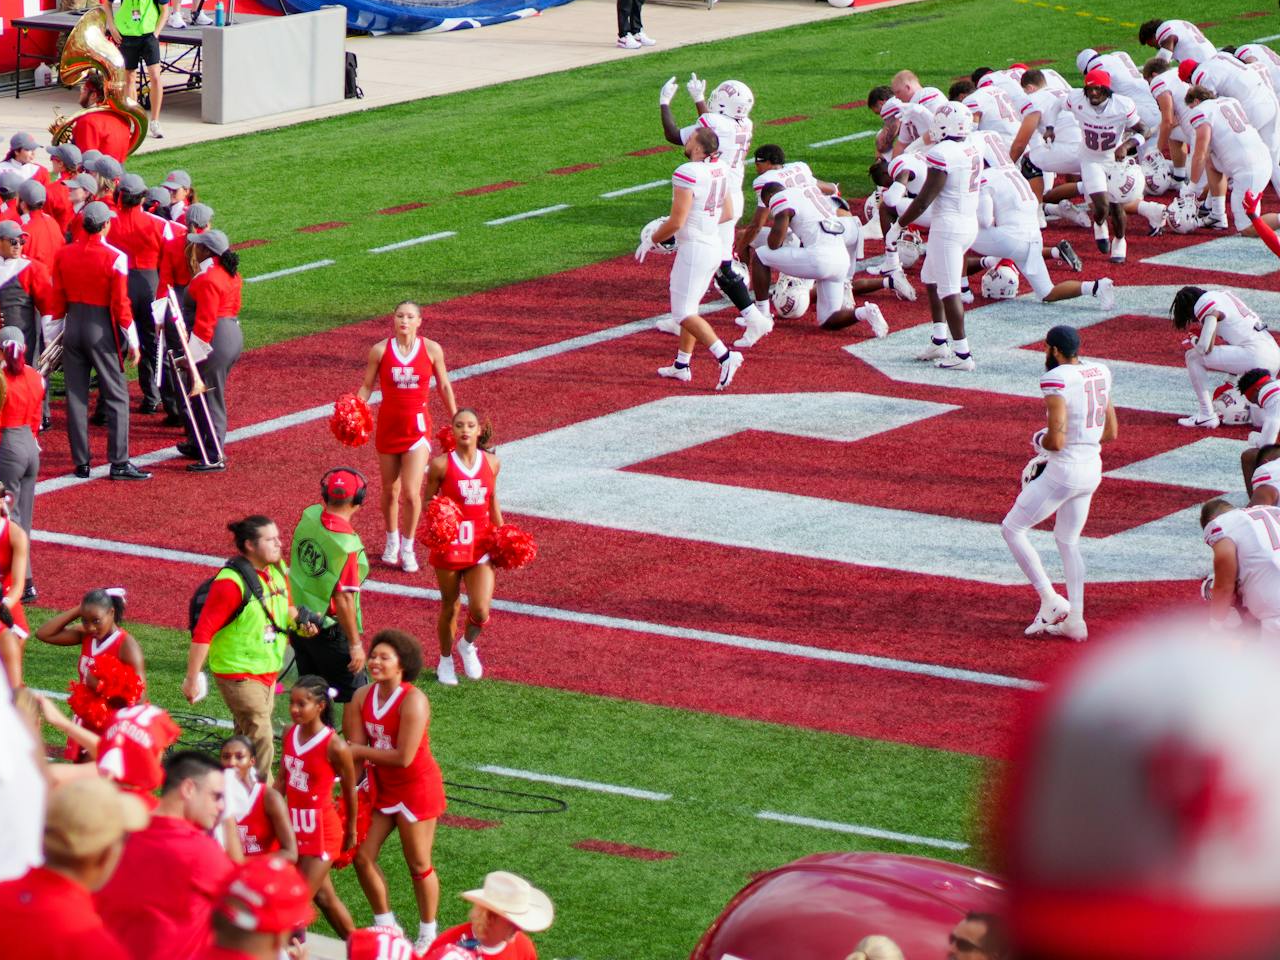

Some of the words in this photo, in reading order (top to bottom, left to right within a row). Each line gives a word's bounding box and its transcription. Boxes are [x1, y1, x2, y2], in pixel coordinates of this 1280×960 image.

[1084, 129, 1117, 152] 82
[1083, 378, 1107, 429] 15
[291, 808, 316, 834] 10
